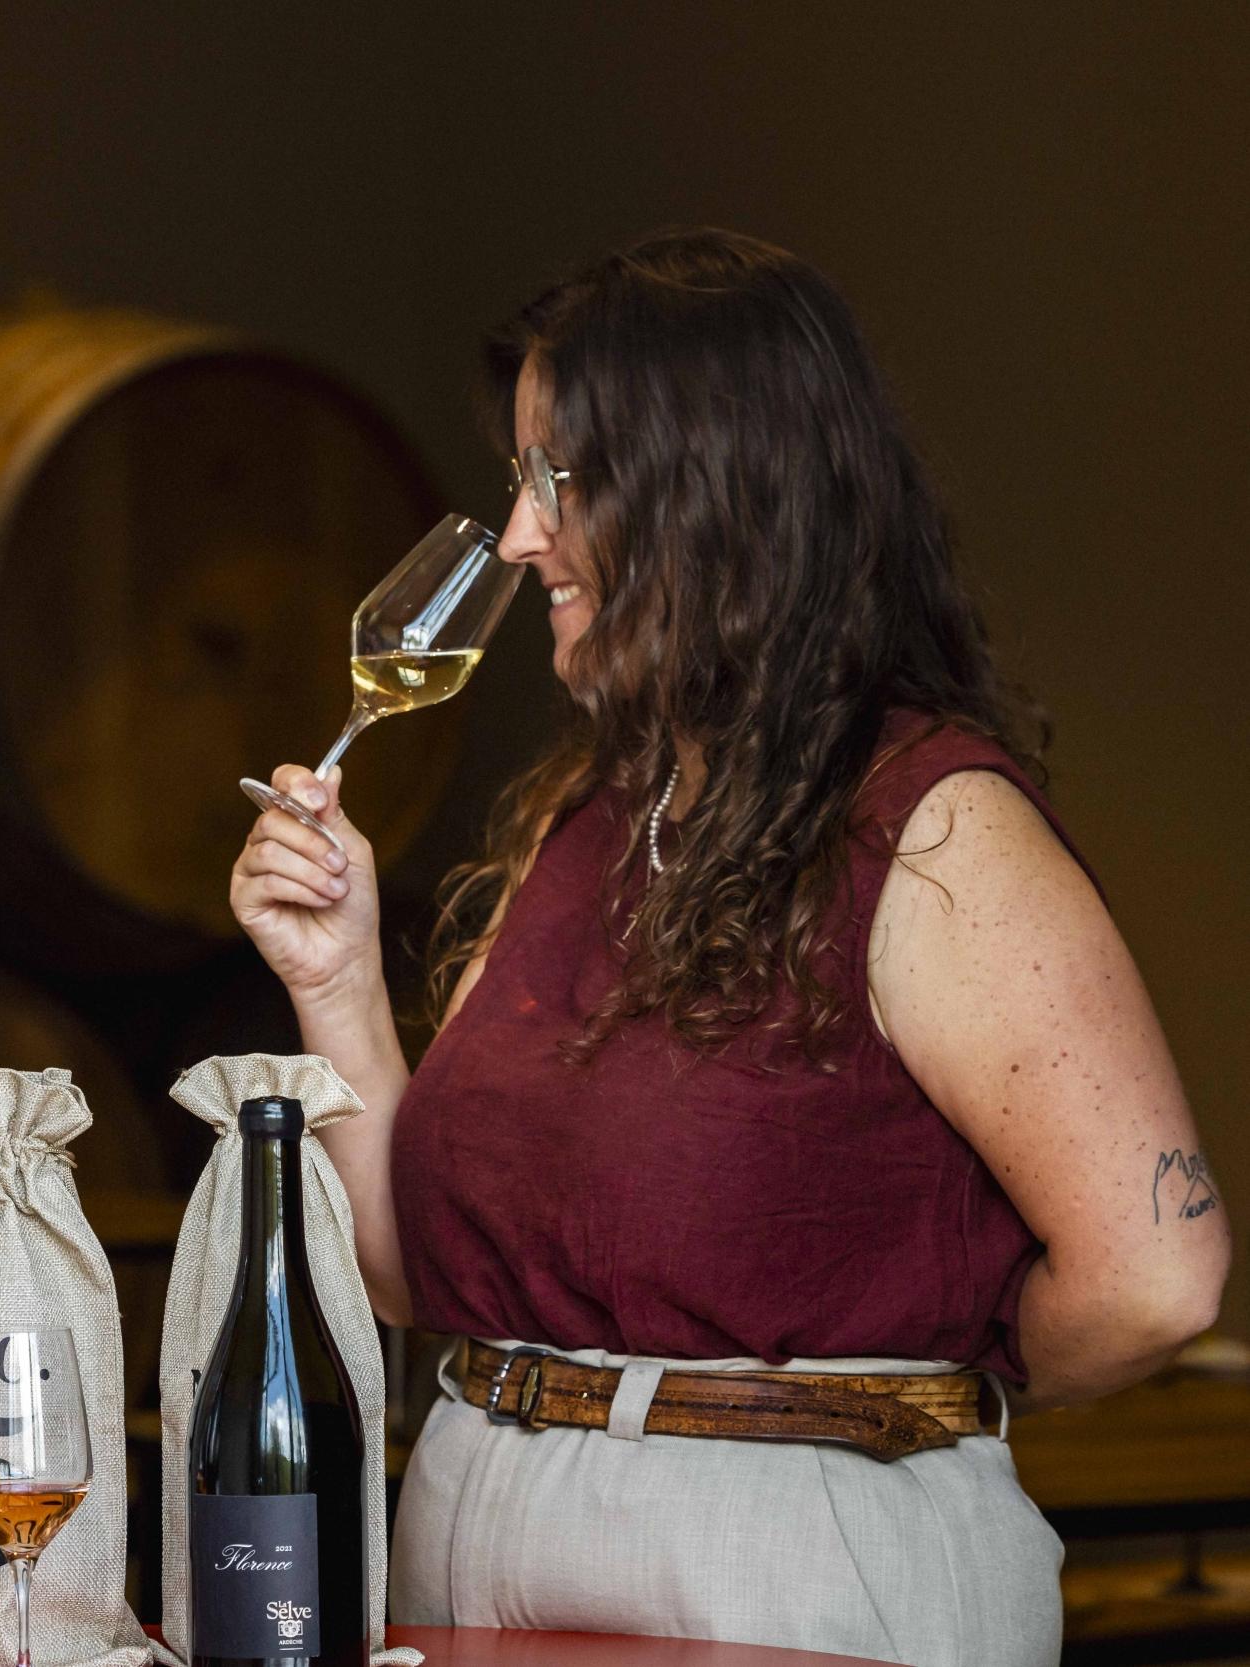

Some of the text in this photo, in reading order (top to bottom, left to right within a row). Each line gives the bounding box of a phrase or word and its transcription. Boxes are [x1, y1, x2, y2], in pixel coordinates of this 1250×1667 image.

[214, 1543, 293, 1571] Florence
[266, 1600, 312, 1620] La Selve
